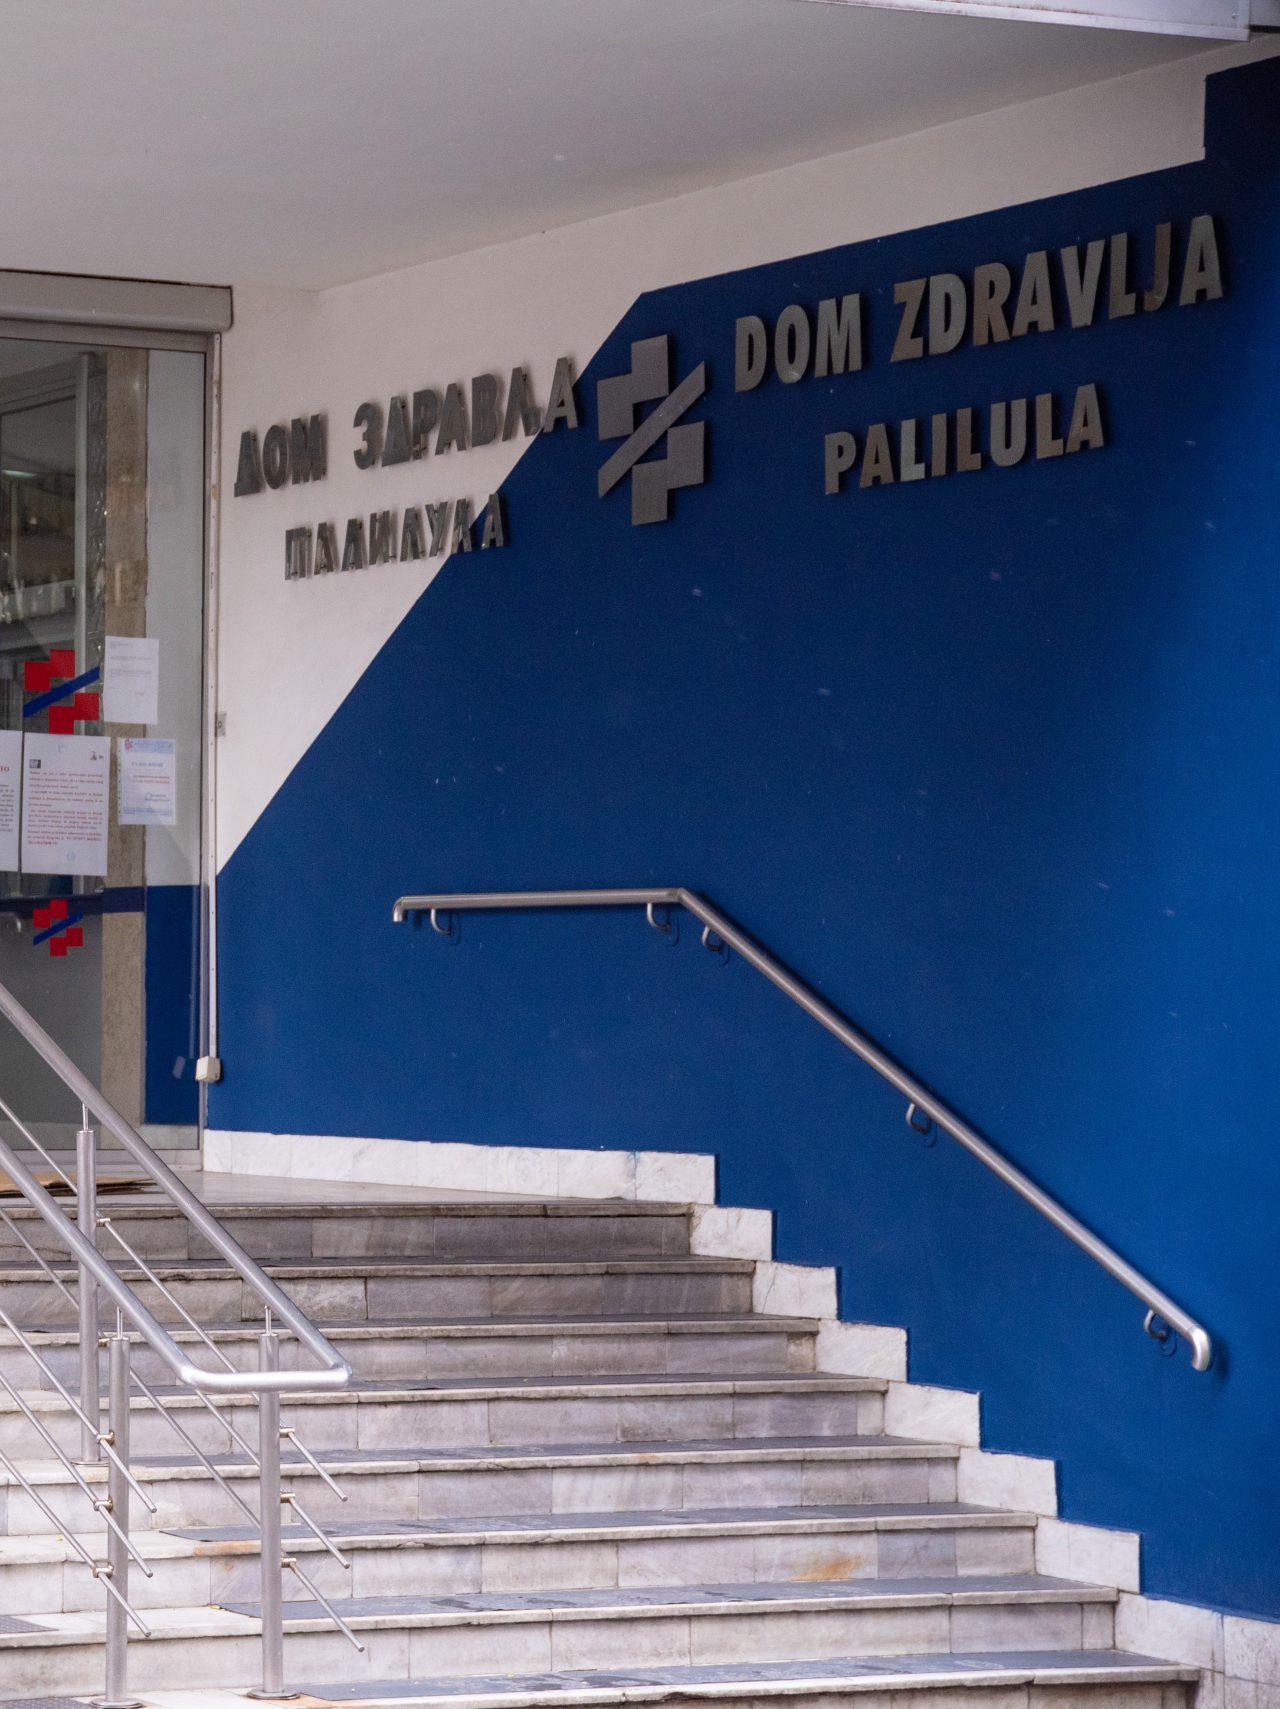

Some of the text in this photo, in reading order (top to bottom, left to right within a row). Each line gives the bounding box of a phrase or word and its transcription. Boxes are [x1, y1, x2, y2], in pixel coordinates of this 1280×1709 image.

[735, 214, 1223, 394] DOM ZDRAVLJA
[234, 356, 578, 498] ДОМ ЗДРАВЉА
[825, 383, 1105, 495] PALILULA
[285, 492, 505, 580] ПАЛИЛУЛА
